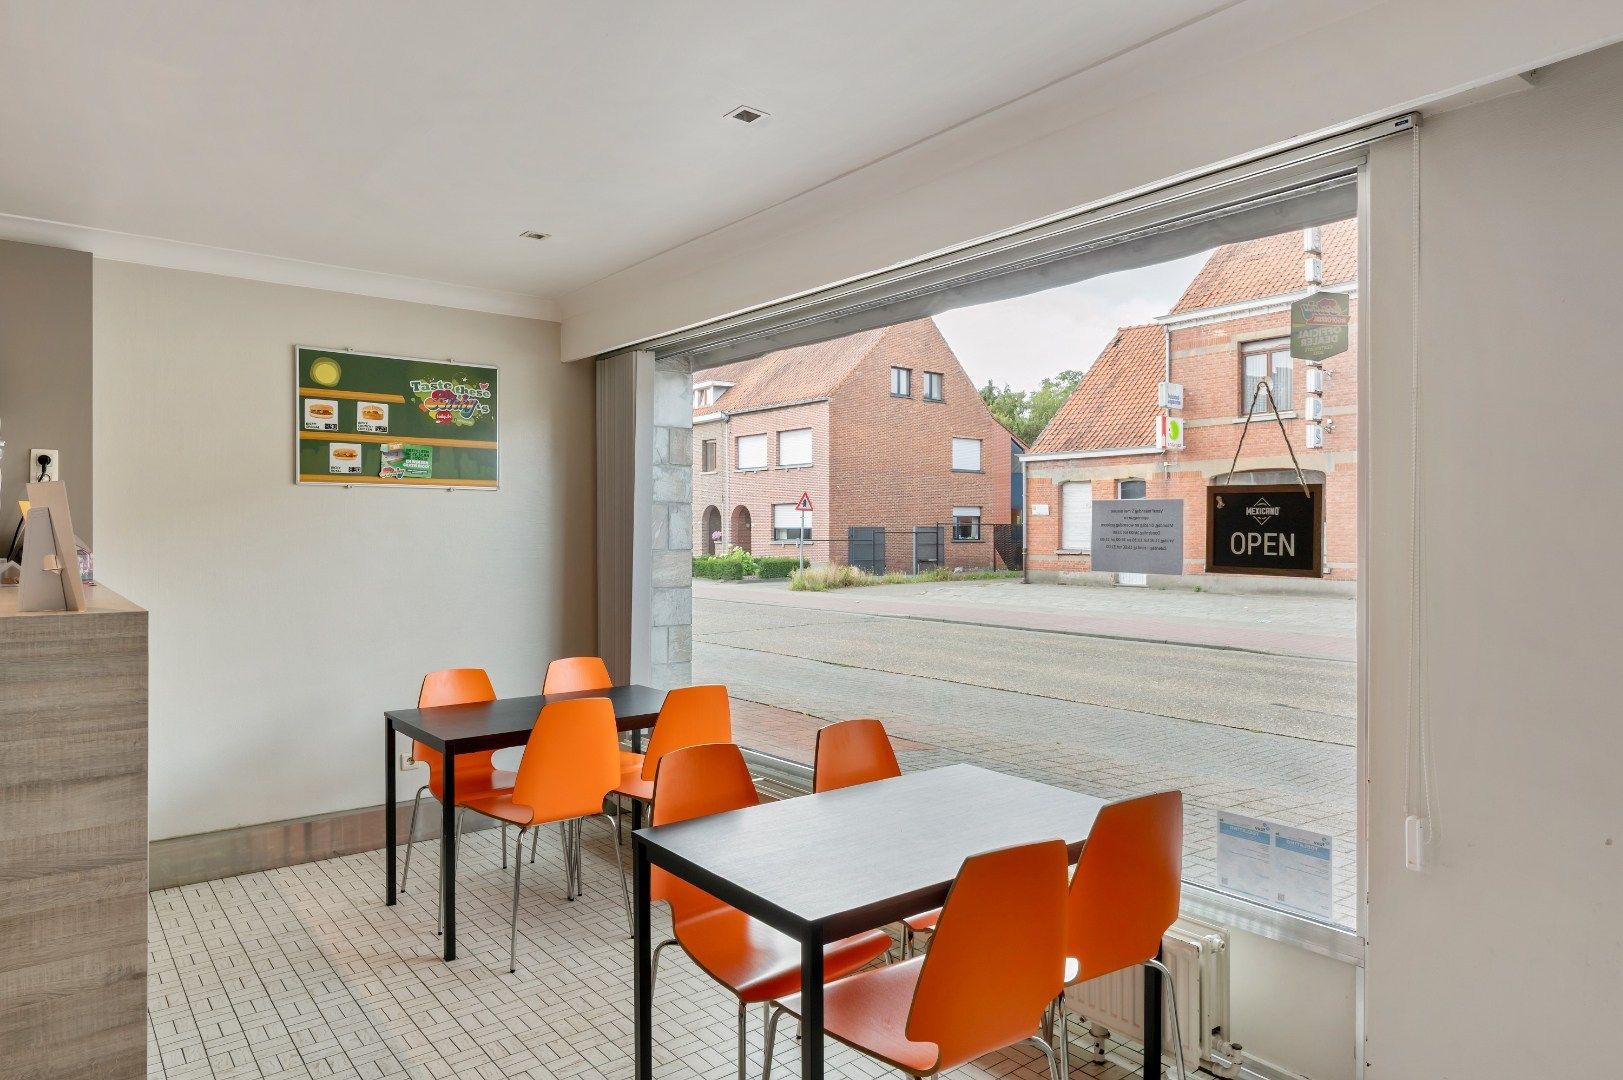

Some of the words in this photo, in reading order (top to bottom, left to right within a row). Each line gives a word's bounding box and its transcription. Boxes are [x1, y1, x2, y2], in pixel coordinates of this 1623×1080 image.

[410, 380, 453, 392] Taste
[454, 385, 491, 398] these
[1245, 507, 1280, 516] MEXICANO
[1230, 531, 1295, 556] OPEN
